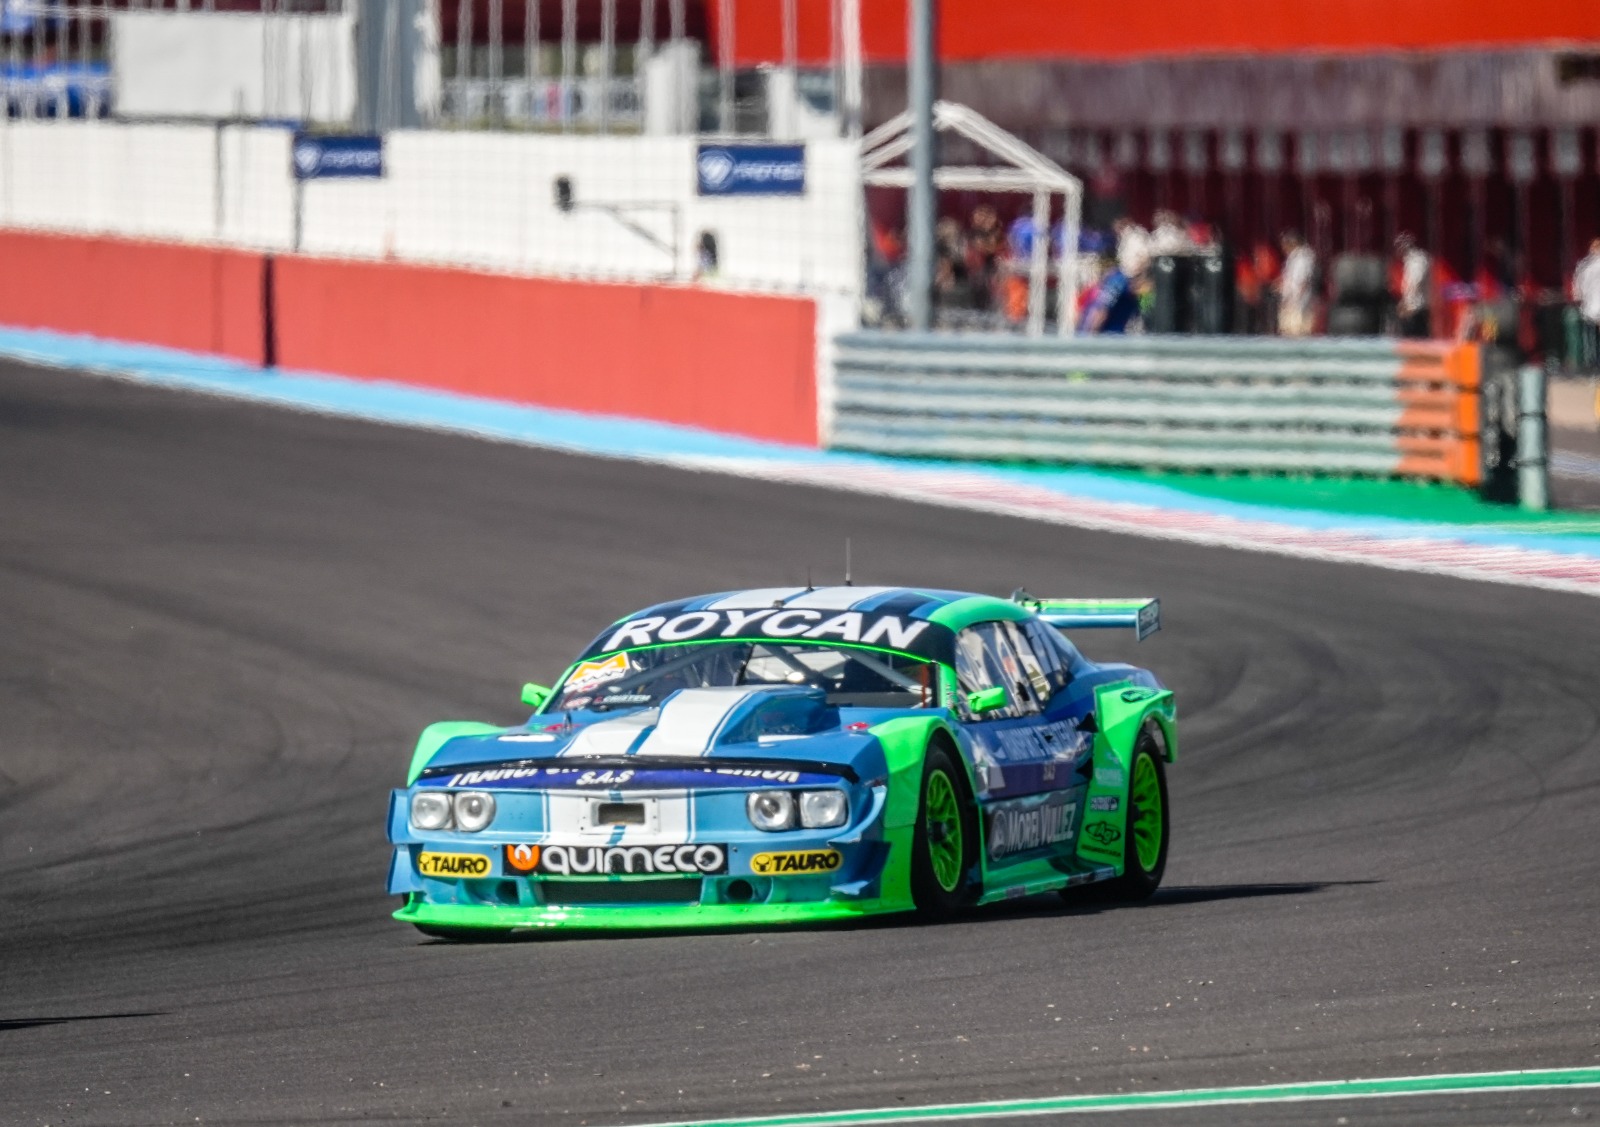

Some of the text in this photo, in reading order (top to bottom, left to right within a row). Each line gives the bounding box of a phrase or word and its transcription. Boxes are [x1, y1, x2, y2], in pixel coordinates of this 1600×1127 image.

[602, 609, 929, 651] ROYCAN
[431, 855, 488, 874] TAURO
[772, 852, 840, 872] TAURO
